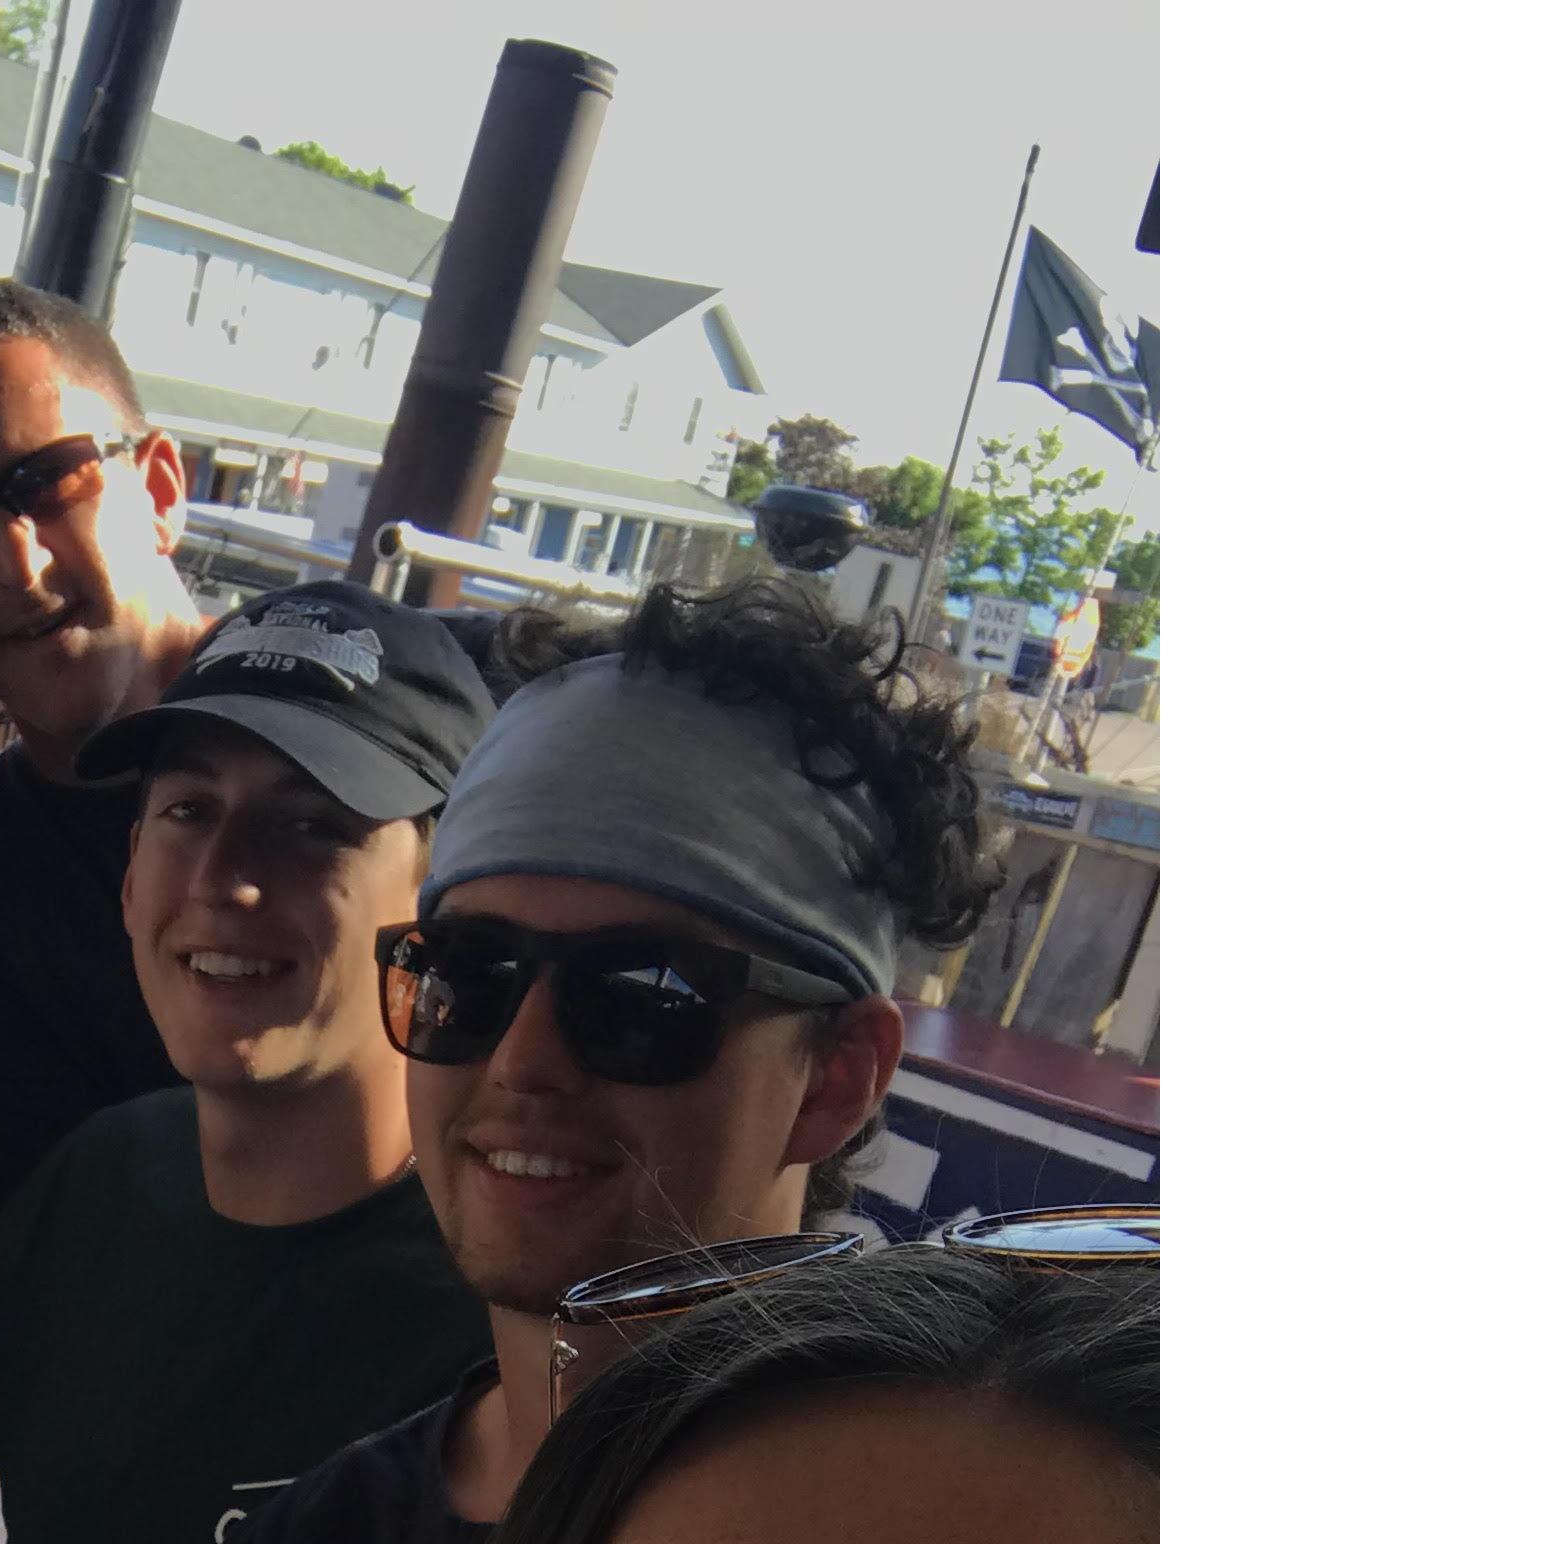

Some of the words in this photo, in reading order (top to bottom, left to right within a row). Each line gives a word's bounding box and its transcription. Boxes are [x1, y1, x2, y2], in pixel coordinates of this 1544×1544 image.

[979, 603, 1018, 626] ONE
[972, 625, 1014, 645] WAY
[240, 653, 297, 672] 2019
